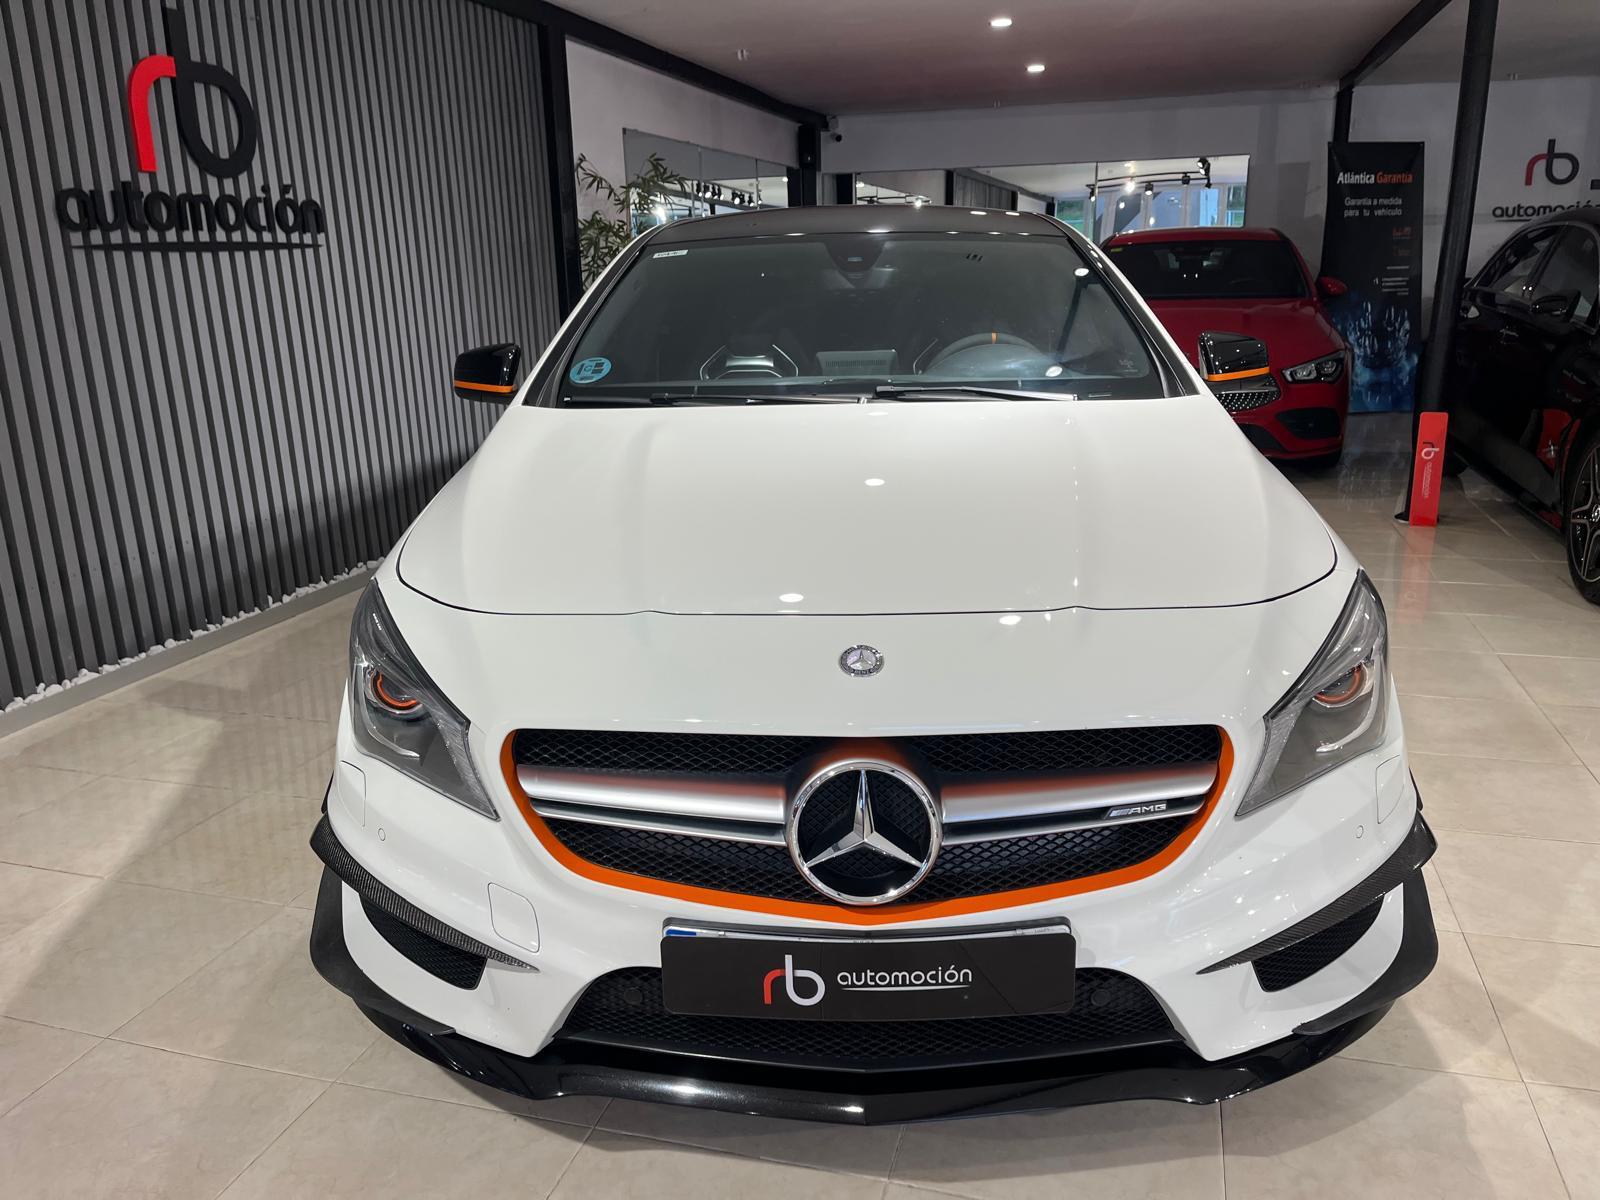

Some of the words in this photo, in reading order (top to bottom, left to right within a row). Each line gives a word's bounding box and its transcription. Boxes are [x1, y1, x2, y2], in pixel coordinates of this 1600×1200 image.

[127, 6, 257, 178] rb
[1337, 171, 1375, 184] Atlántica
[1525, 139, 1580, 186] rb
[55, 180, 325, 235] automoción
[1344, 209, 1360, 218] para
[1363, 208, 1370, 216] tu
[1492, 200, 1600, 218] autom
[1128, 803, 1167, 815] AMG
[763, 954, 826, 1006] rb
[837, 964, 973, 986] automoción
